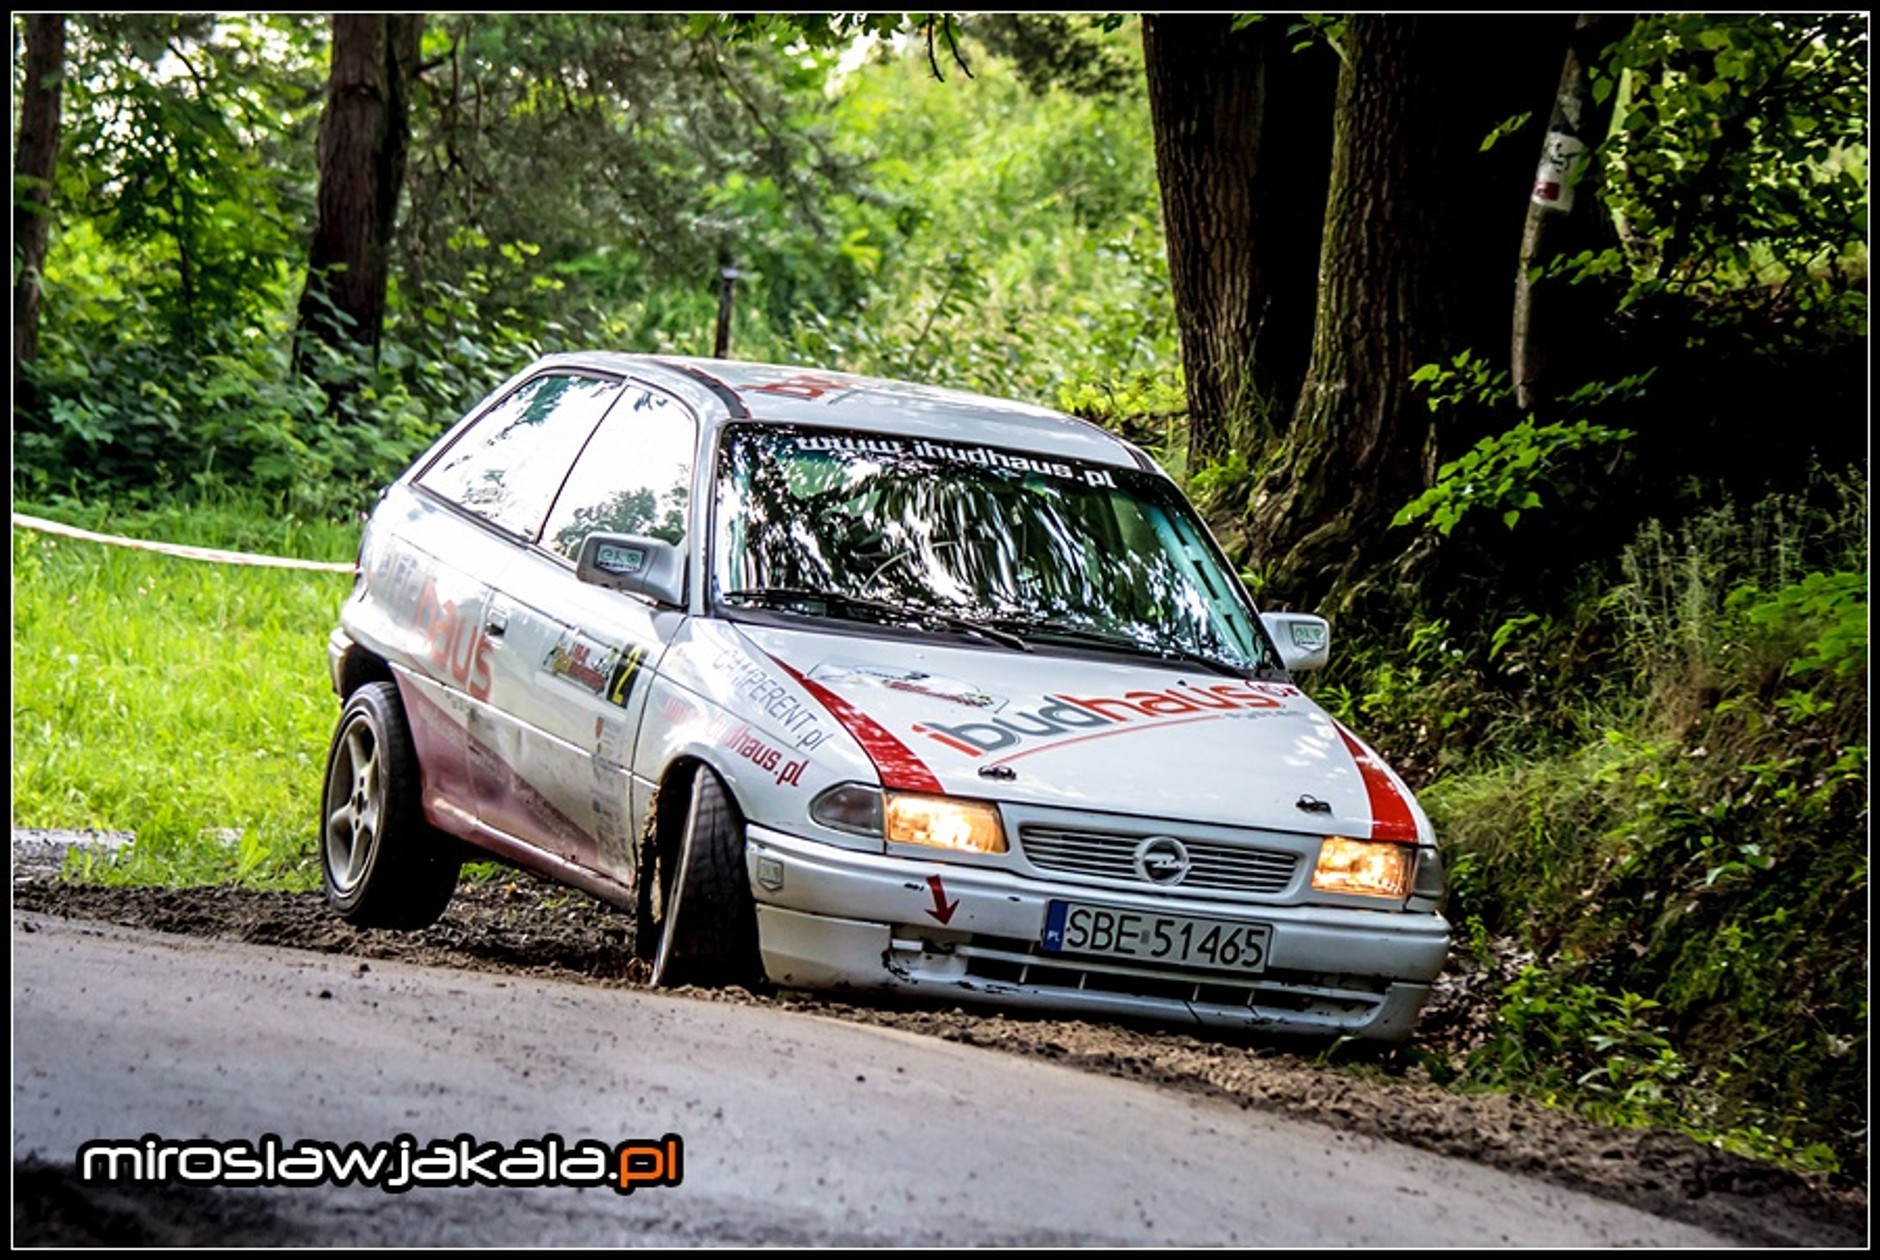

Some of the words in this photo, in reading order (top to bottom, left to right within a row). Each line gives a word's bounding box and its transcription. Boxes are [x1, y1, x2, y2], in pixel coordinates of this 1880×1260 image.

[911, 683, 1287, 758] ibudhaus
[1047, 930, 1061, 942] PL
[1066, 908, 1142, 955] SBE
[1151, 919, 1266, 968] 51465
